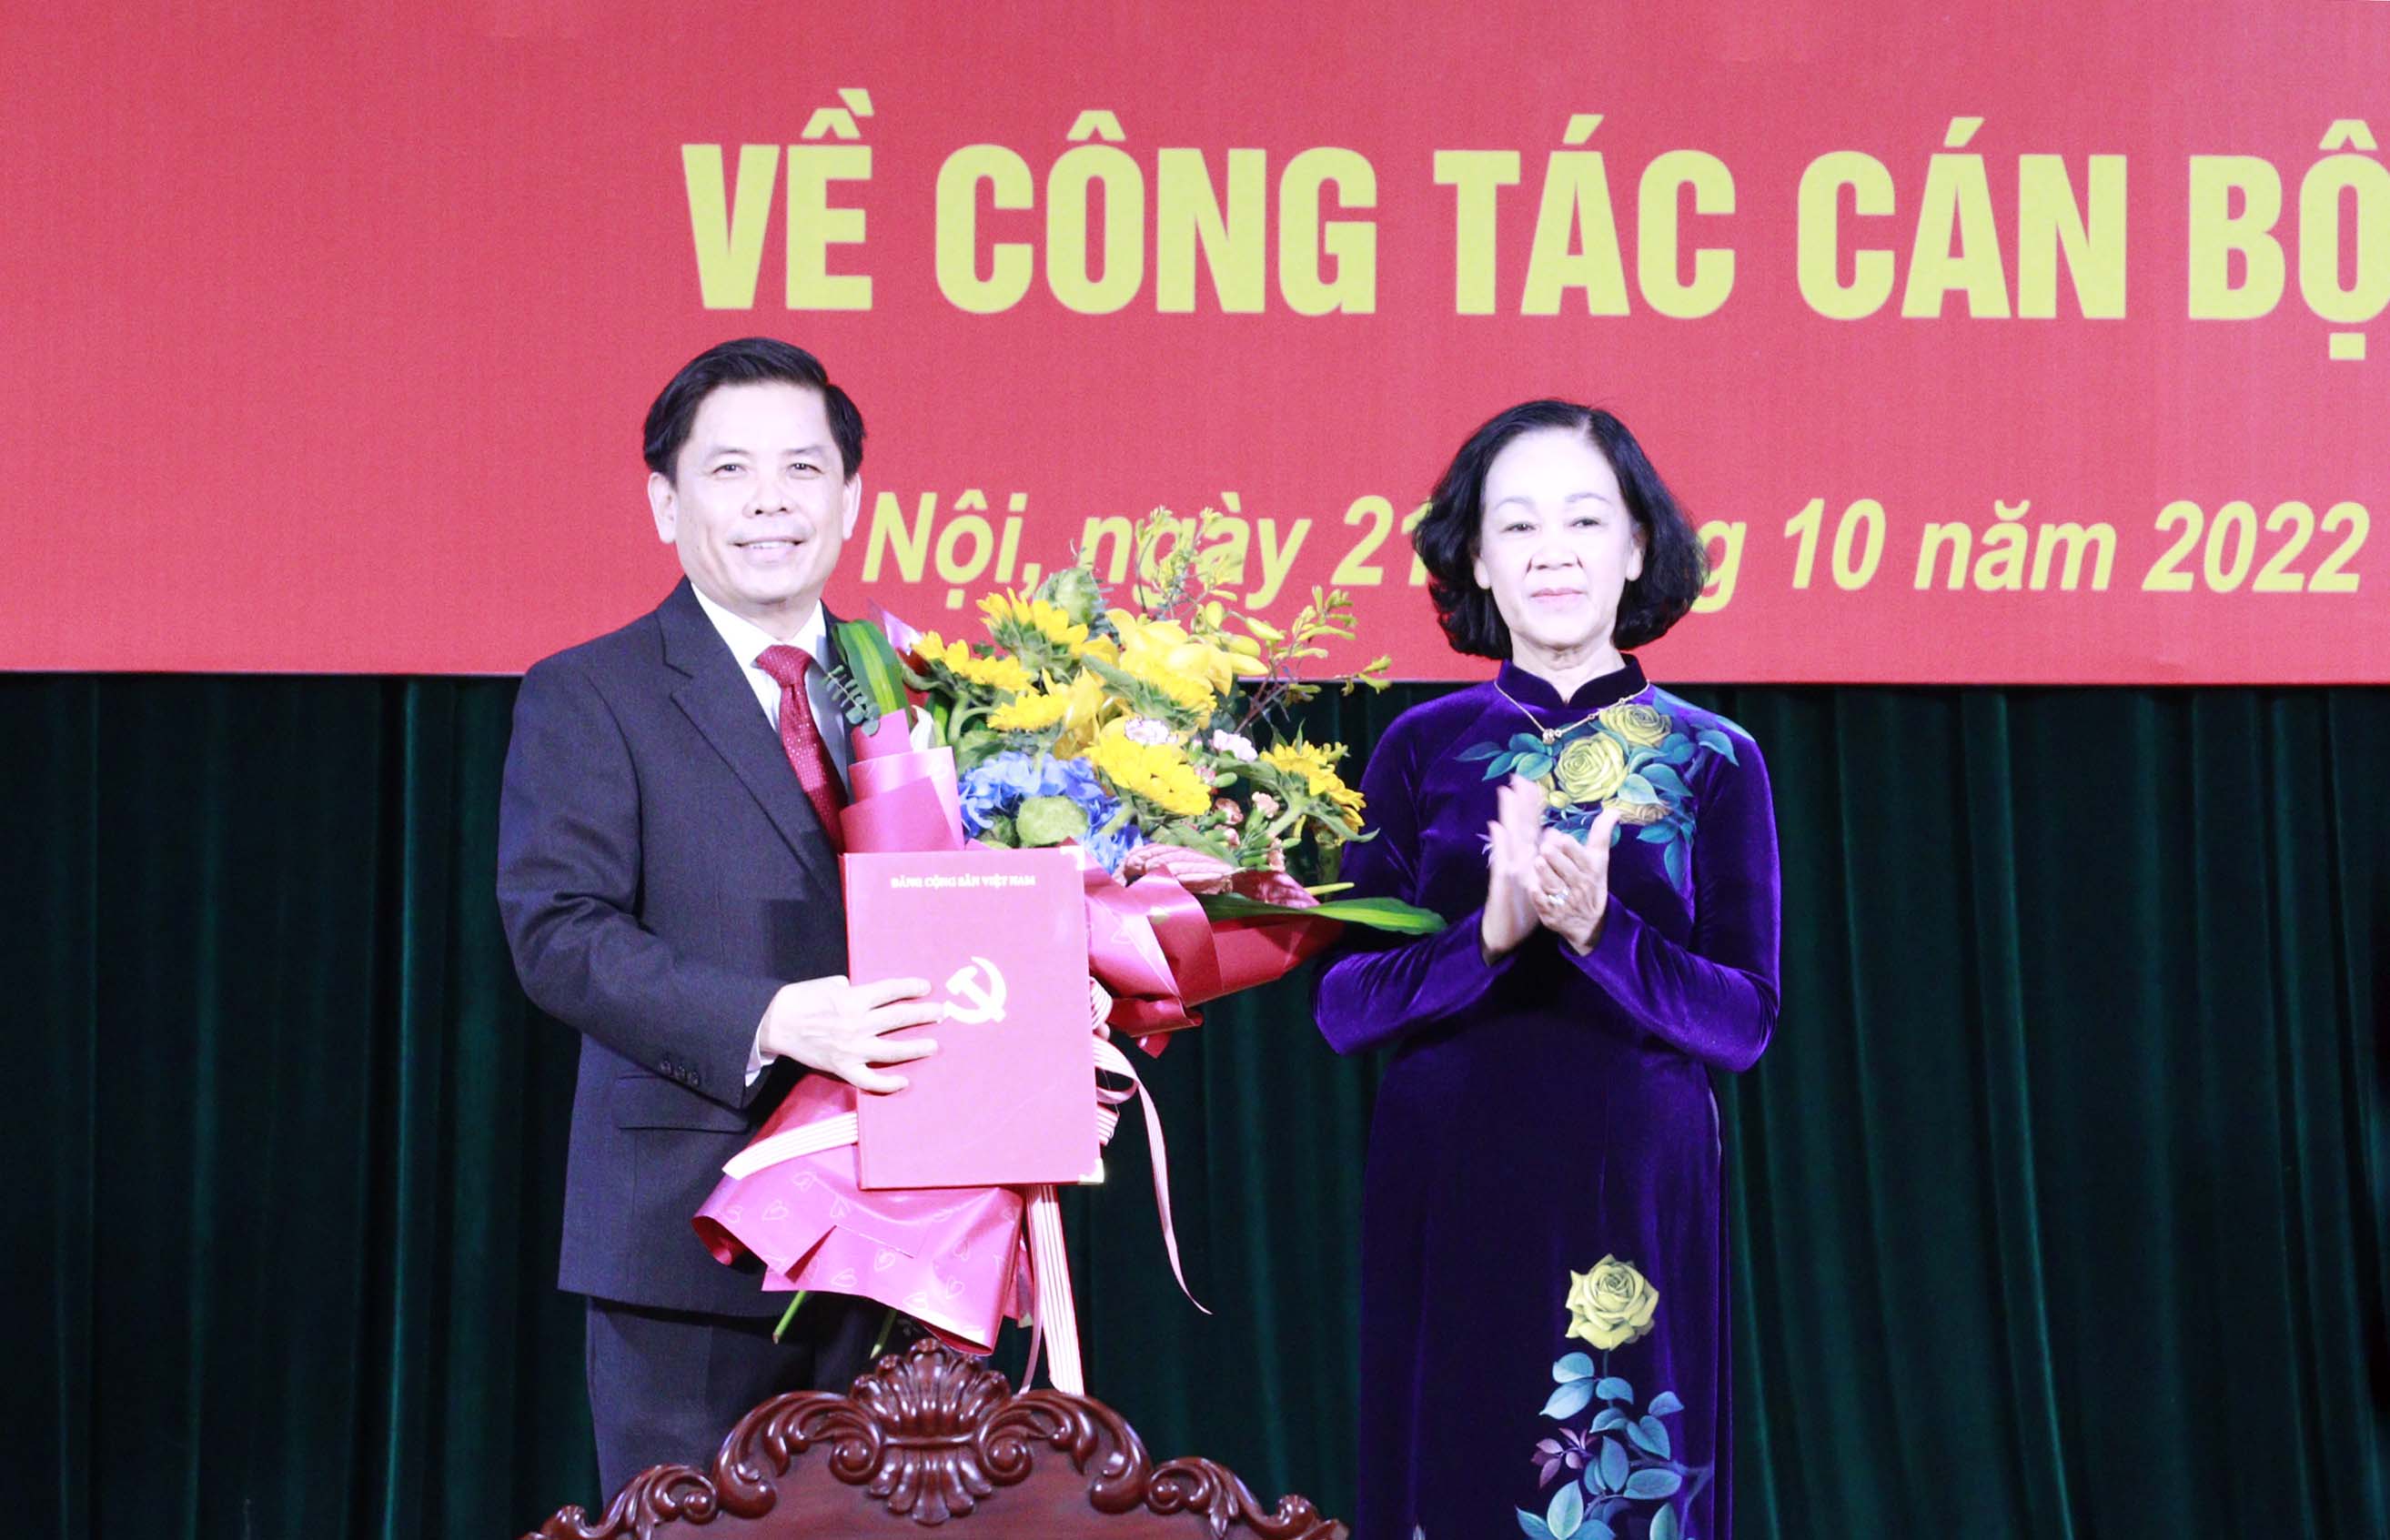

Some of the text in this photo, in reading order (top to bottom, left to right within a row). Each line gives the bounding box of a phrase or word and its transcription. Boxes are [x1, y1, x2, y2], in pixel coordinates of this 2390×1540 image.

[681, 88, 2390, 361] VỀ CÔNG TÁC CÁN BỘ
[862, 488, 1044, 609] Nội,
[1076, 491, 1313, 611] ngày
[1784, 498, 1887, 591] 10
[1913, 499, 2117, 592] năm
[2141, 499, 2371, 594] 2022
[1009, 874, 1036, 887] NAM
